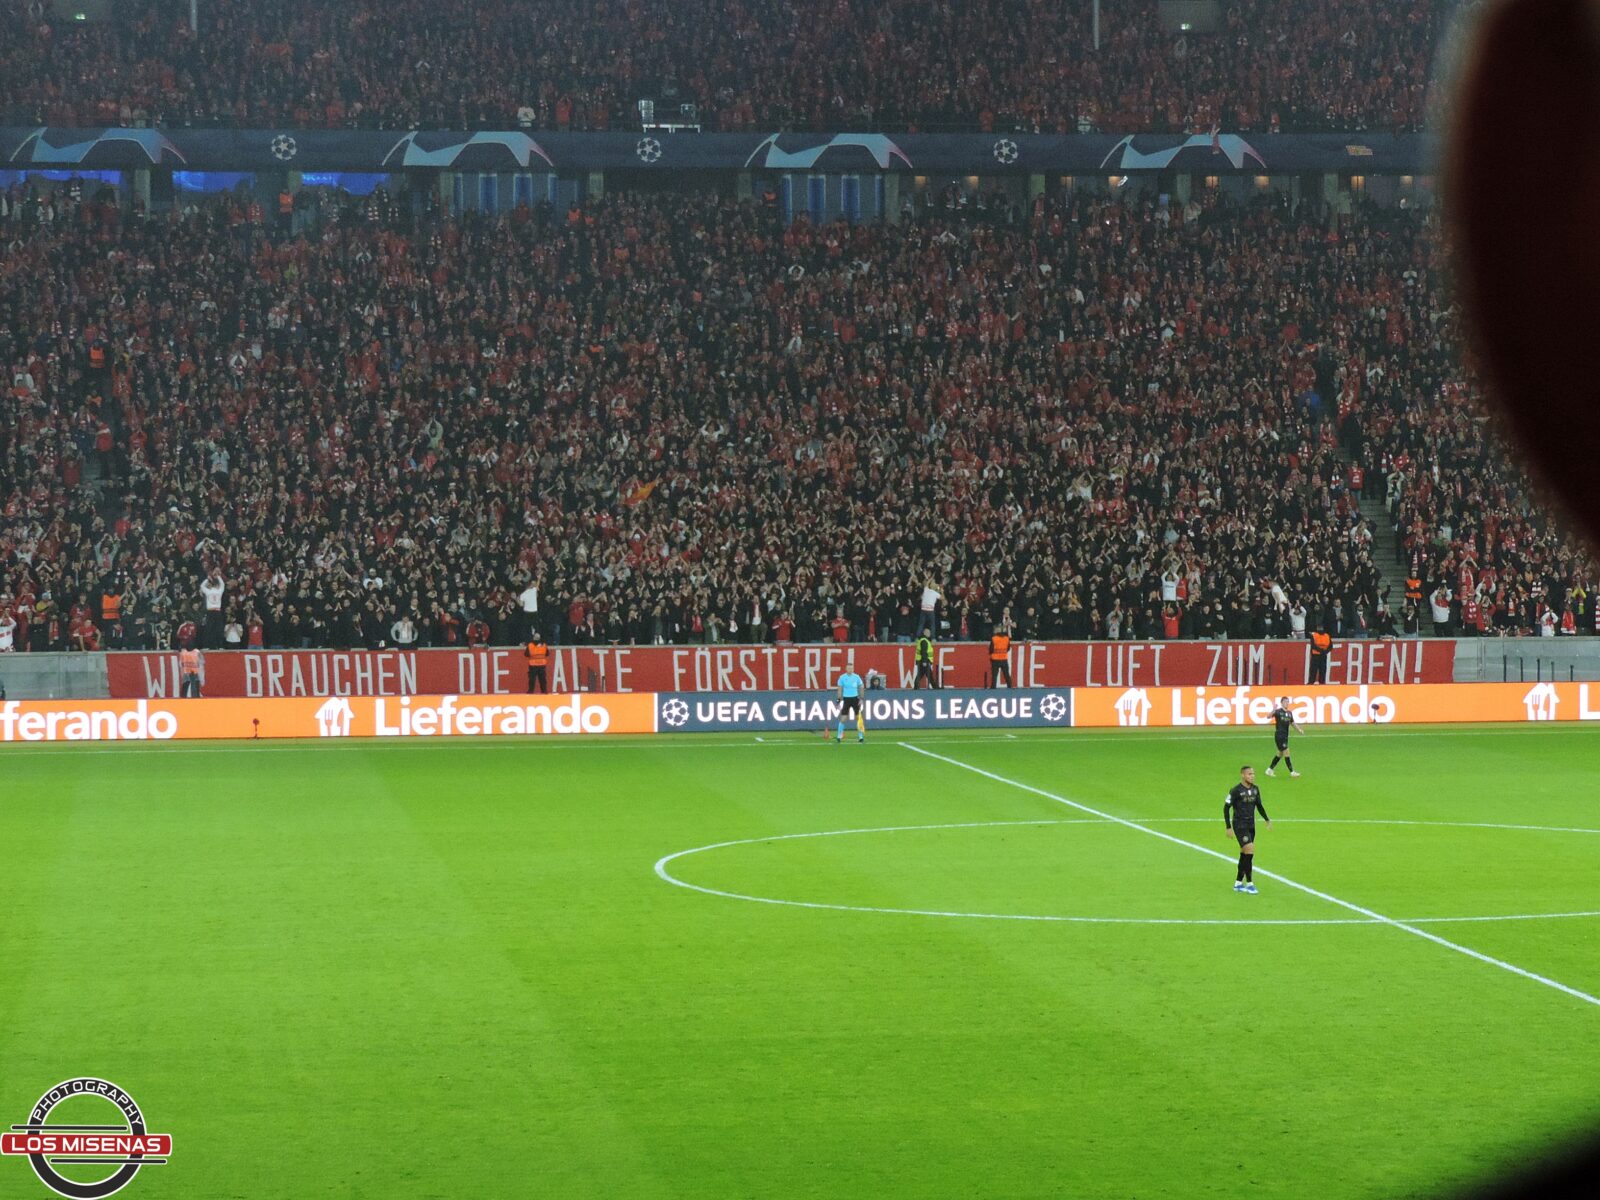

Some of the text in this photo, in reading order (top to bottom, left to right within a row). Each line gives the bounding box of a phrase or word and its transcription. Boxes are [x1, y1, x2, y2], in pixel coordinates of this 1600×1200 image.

[142, 655, 203, 698] WI
[244, 652, 417, 698] BRAUCHEN
[458, 651, 510, 695] DIE
[552, 648, 633, 693] ALTE
[898, 647, 955, 689] WE
[1086, 644, 1166, 688] LUFT
[1205, 643, 1266, 686] ZUM
[0, 699, 178, 740] ferando
[375, 693, 610, 736] Lieferando
[696, 701, 765, 723] UEFA
[935, 697, 1033, 720] LEAGUE
